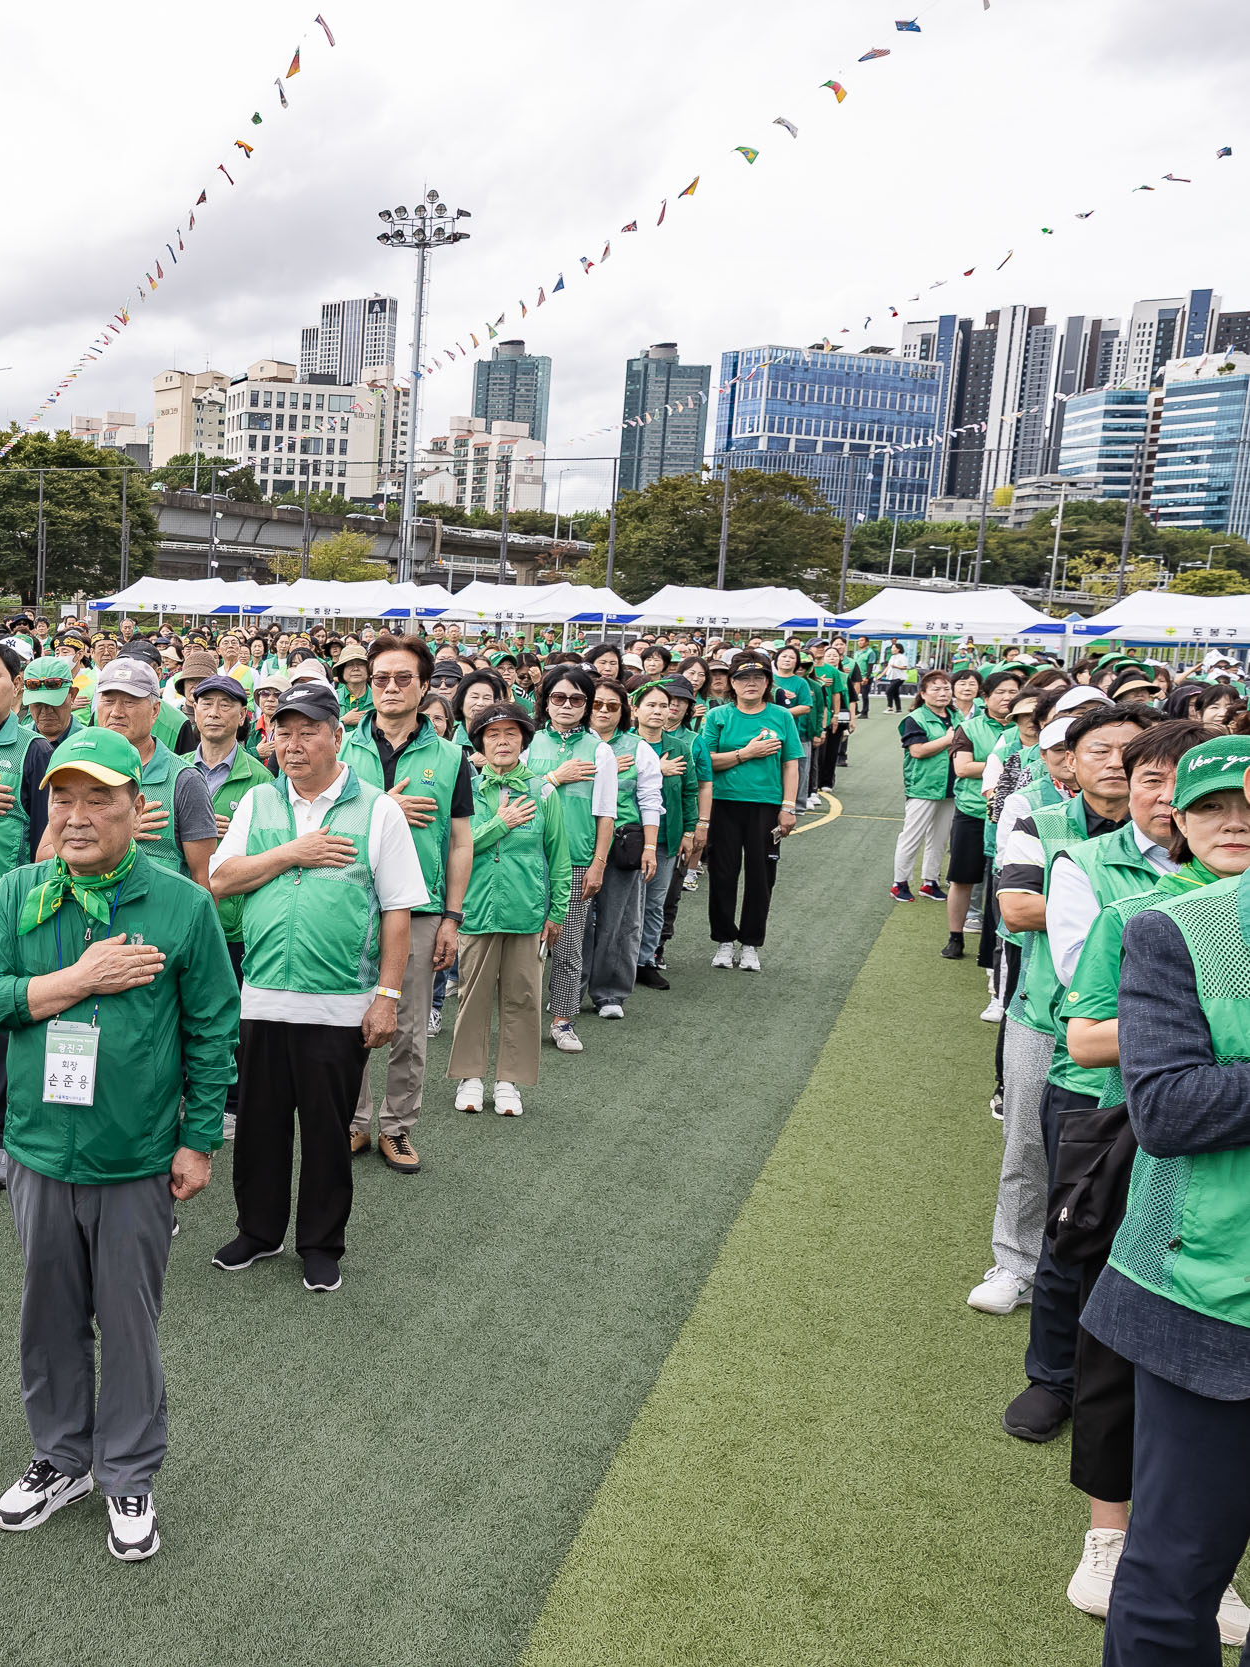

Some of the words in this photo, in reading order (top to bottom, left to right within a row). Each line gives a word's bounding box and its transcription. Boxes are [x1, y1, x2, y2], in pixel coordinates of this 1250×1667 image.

[494, 612, 525, 620] 성북구
[696, 616, 730, 625] 강북구
[925, 622, 964, 632] 강북구
[1192, 627, 1238, 637] 도봉구
[1221, 755, 1250, 771] yo
[62, 1060, 78, 1072] 회장
[48, 1073, 90, 1090] 손준용
